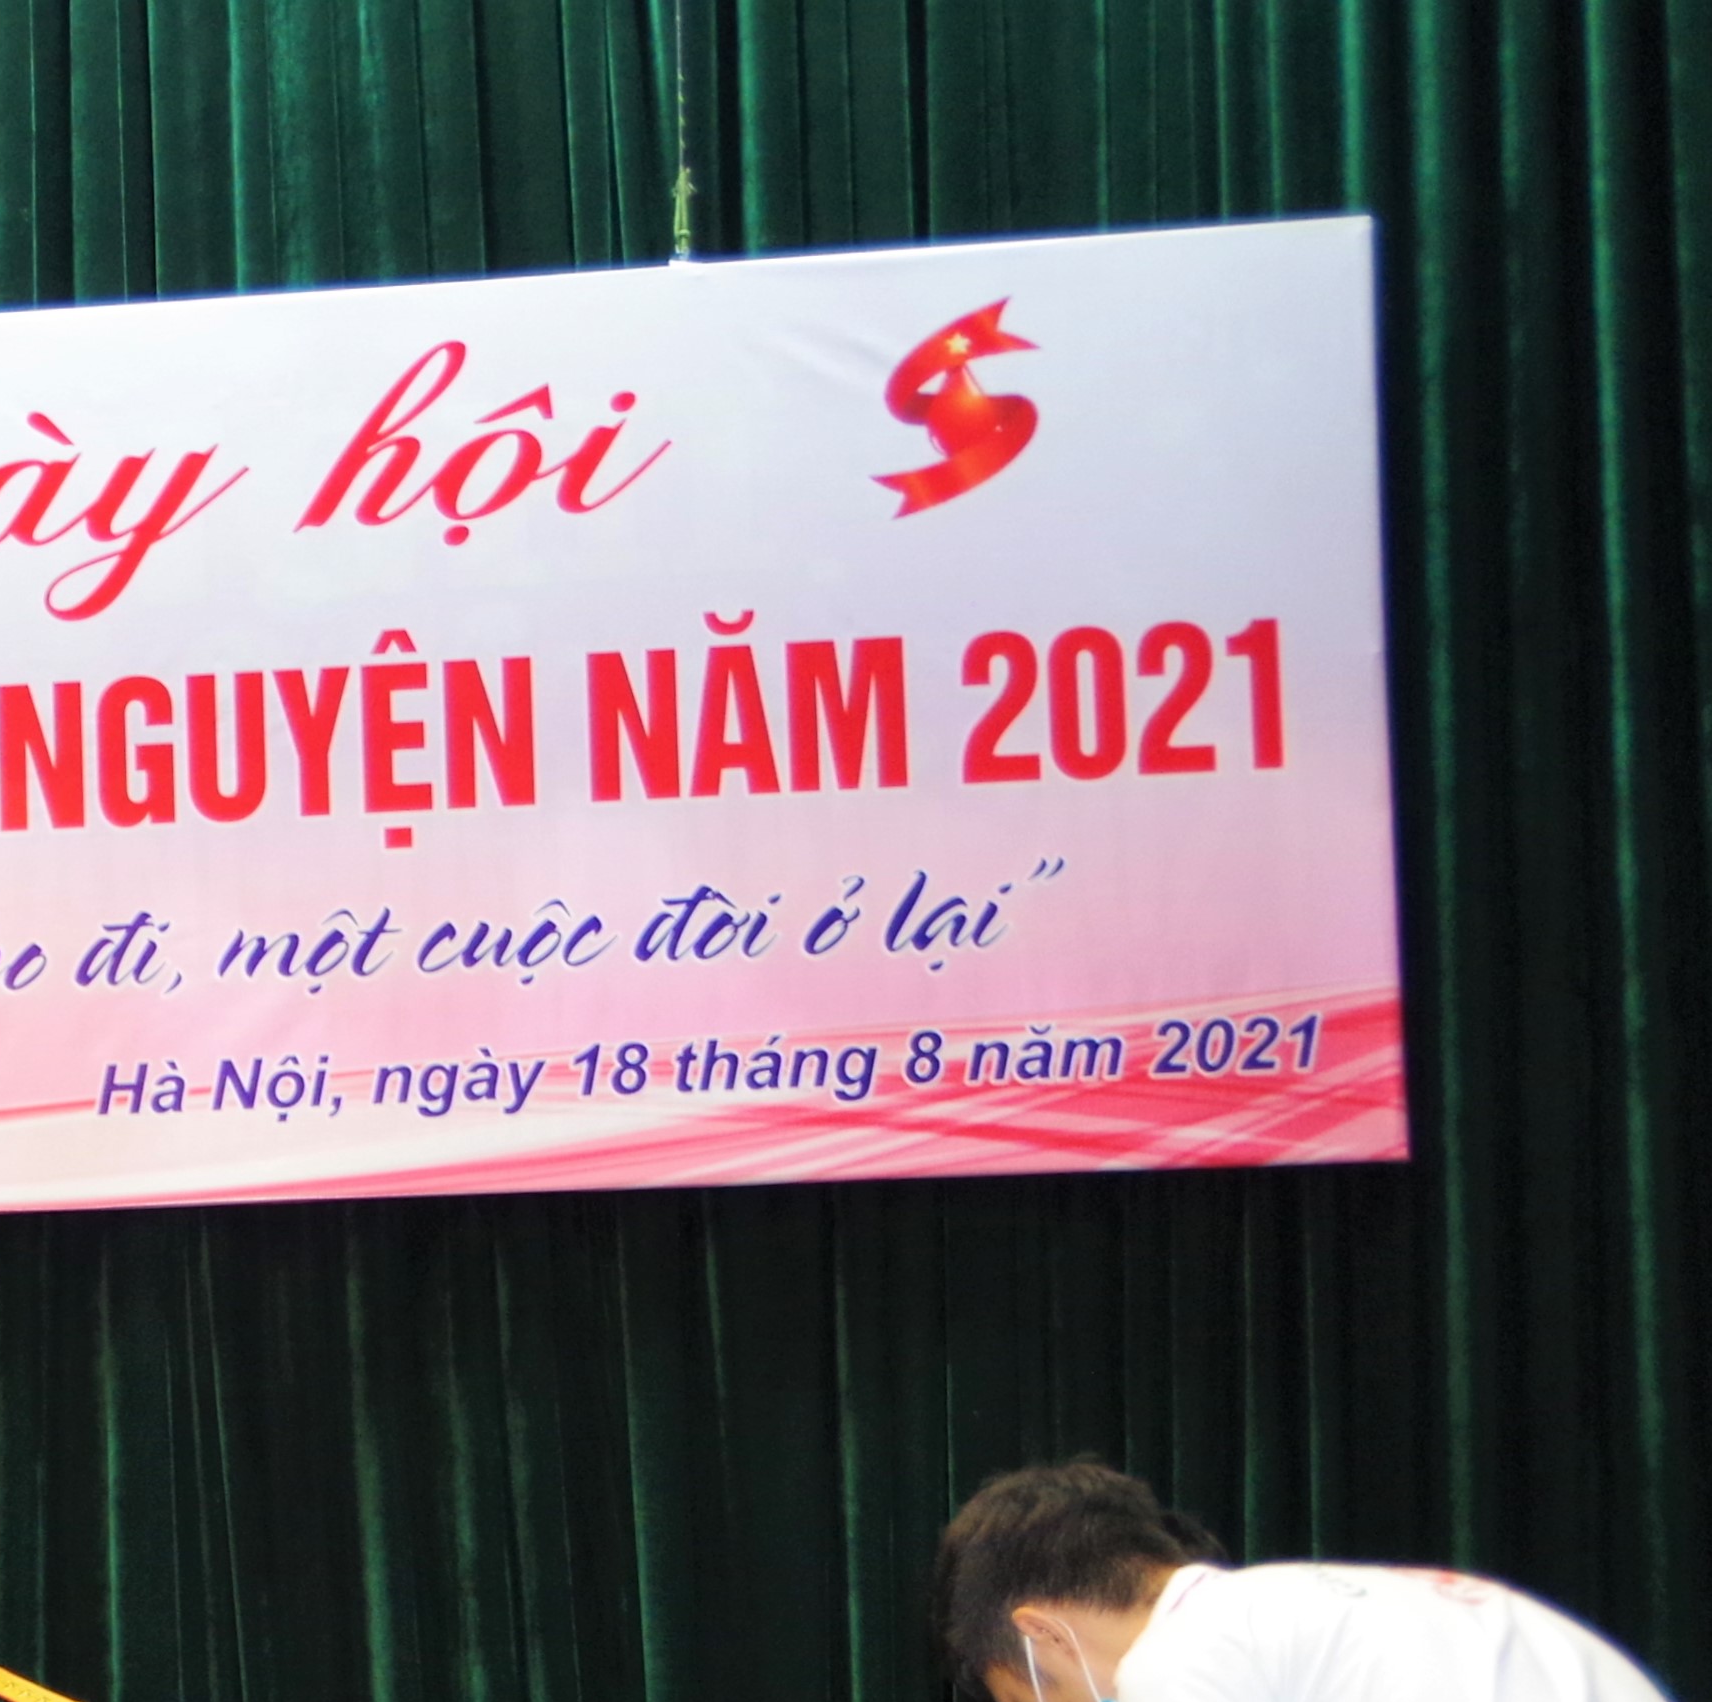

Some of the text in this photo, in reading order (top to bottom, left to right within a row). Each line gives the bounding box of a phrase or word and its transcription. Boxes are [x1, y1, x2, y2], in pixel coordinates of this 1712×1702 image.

[292, 340, 672, 545] hội
[587, 610, 910, 804] NĂM
[958, 617, 1287, 786] 2021
[73, 912, 185, 994] đi,
[218, 908, 403, 995] một
[416, 899, 619, 989] cuộc
[631, 883, 781, 966] đời
[803, 878, 866, 960] ở
[97, 1014, 1324, 1124] Hà Nội, ngày 18 tháng 8 năm 2021
